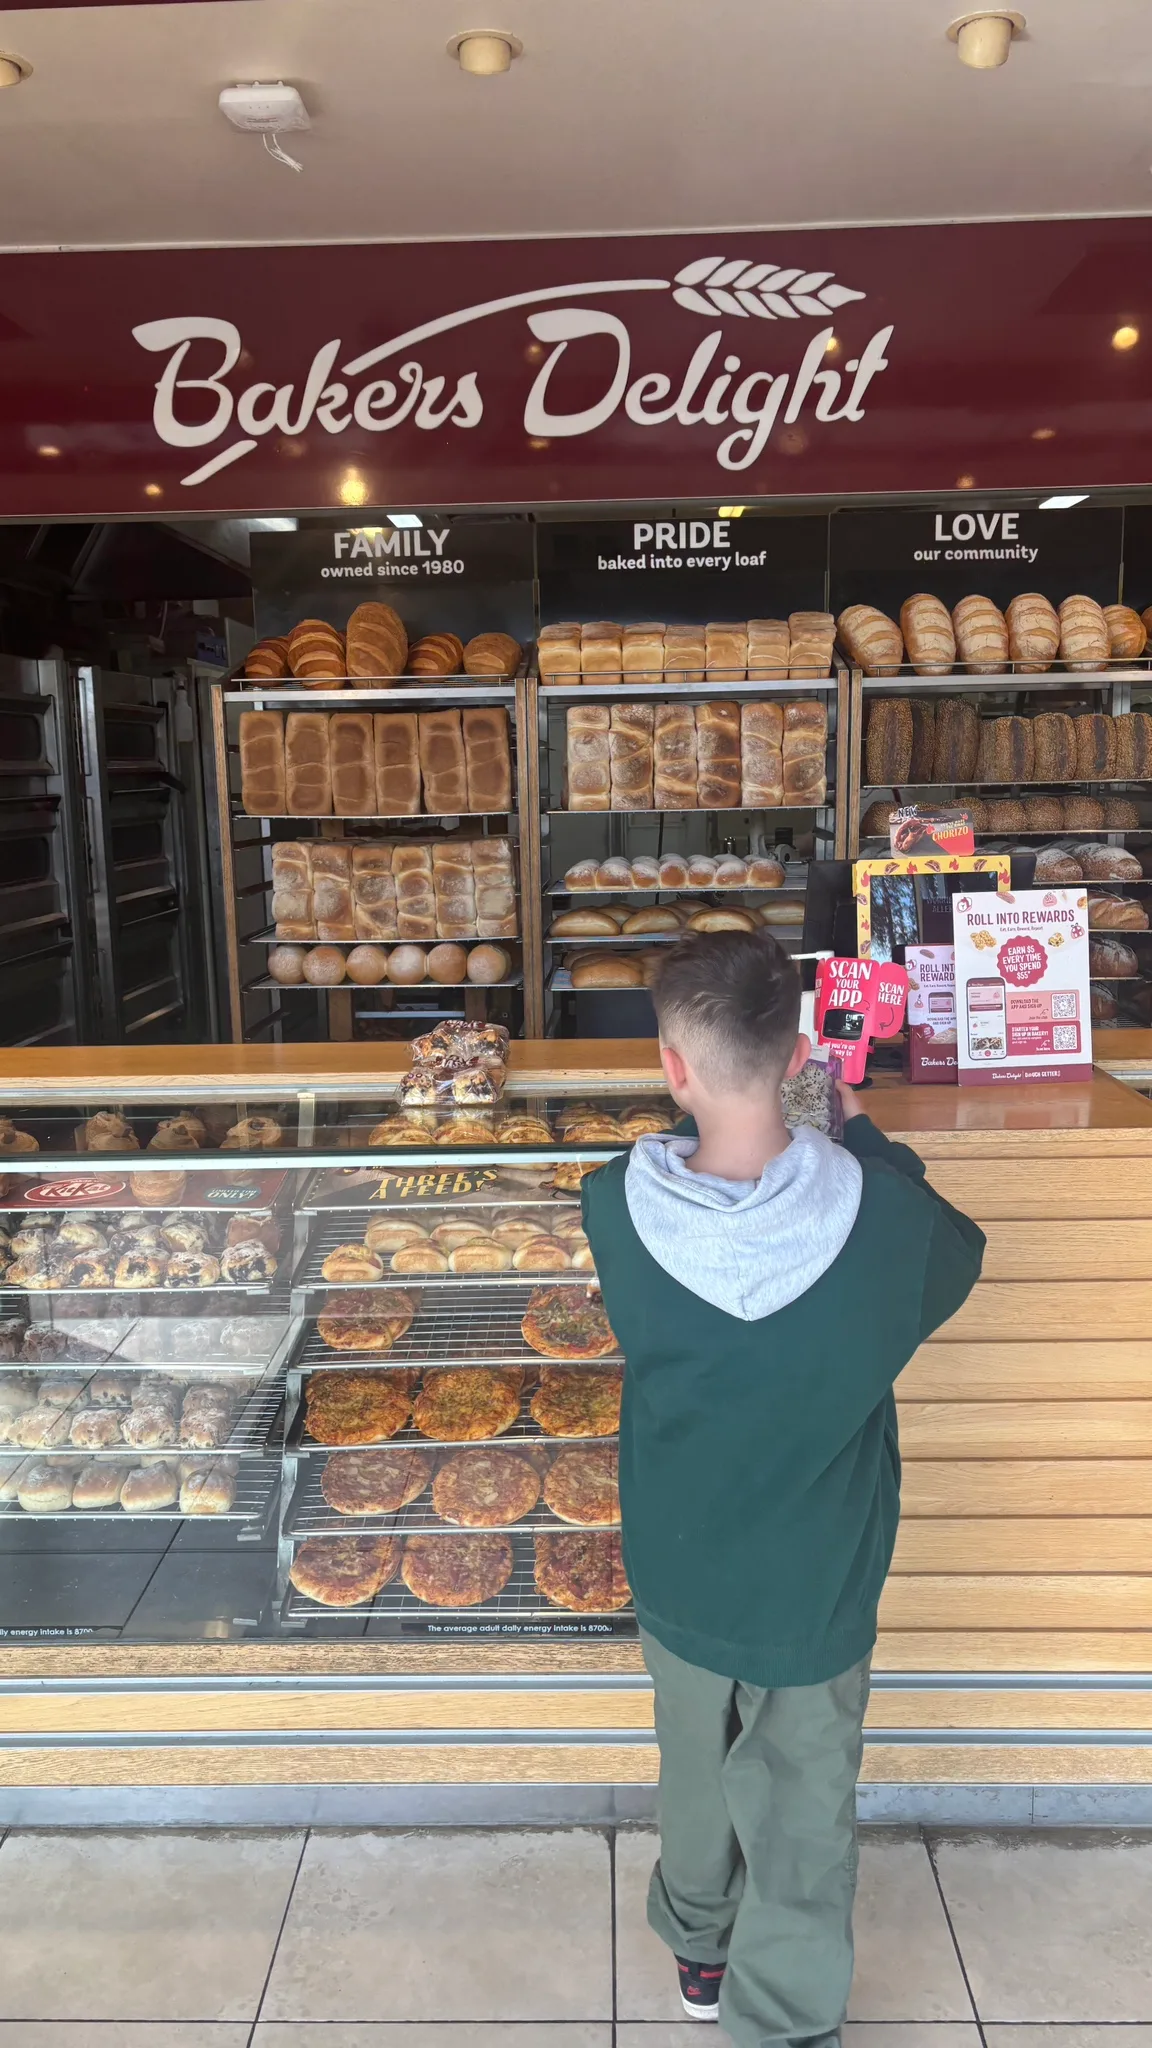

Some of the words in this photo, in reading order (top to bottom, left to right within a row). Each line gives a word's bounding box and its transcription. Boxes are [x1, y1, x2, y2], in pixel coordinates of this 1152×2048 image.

[132, 316, 484, 485] Bakers
[524, 308, 895, 470] Delight
[633, 520, 731, 550] PRIDE
[935, 512, 1020, 541] LOVE
[334, 528, 450, 559] FAMILY
[597, 554, 647, 570] baked
[650, 553, 683, 569] into
[686, 554, 731, 571] every
[735, 551, 767, 567] loaf
[913, 549, 941, 561] our
[944, 543, 1039, 563] community
[320, 561, 373, 578] owned
[377, 561, 419, 576] since
[421, 559, 465, 575] 1980
[931, 825, 969, 842] CHORIZO
[967, 913, 994, 926] ROLL
[996, 912, 1020, 925] INTO
[1022, 909, 1075, 924] REWARDS
[1002, 954, 1025, 965] EVERY
[1026, 953, 1042, 962] TIME
[1008, 946, 1026, 956] EARN
[1026, 945, 1035, 954] $5
[829, 959, 873, 980] SCAN
[920, 963, 941, 973] ROLL
[942, 963, 954, 973] INT
[1004, 964, 1018, 973] YOU
[1018, 962, 1042, 972] SPEND
[836, 978, 860, 990] YOUR
[920, 972, 955, 982] REWARD
[879, 981, 905, 995] SCAN
[828, 989, 863, 1008] APP
[877, 992, 904, 1006] HERE
[920, 1056, 946, 1066] Bakers
[376, 1169, 498, 1189] THREE'S
[368, 1187, 388, 1200] A
[400, 1180, 485, 1198] FEED!
[501, 1624, 521, 1634] daily
